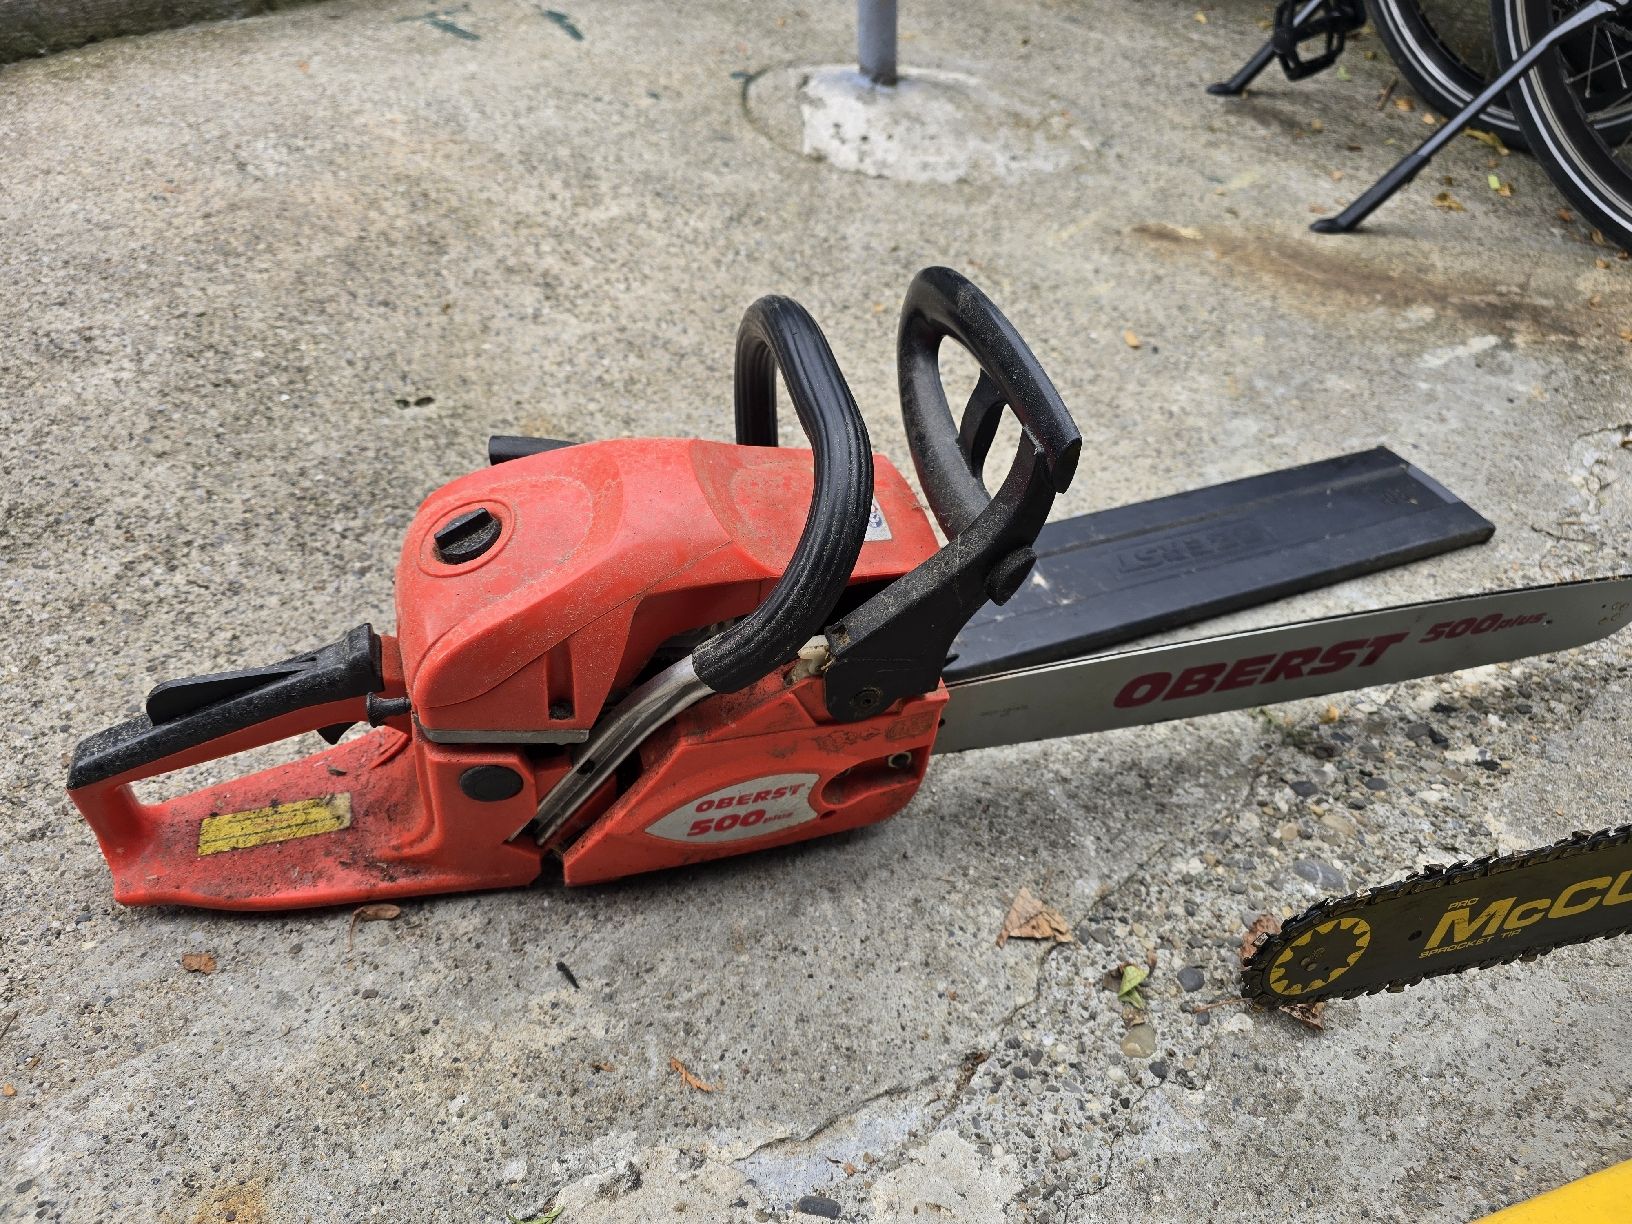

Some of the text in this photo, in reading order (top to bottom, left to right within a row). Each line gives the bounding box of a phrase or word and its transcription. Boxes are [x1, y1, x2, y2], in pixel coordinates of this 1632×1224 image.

[1114, 633, 1409, 708] OBERST
[695, 783, 806, 813] OBERST
[1447, 897, 1480, 910] PRO
[1419, 929, 1522, 959] SPROCKET TIP
